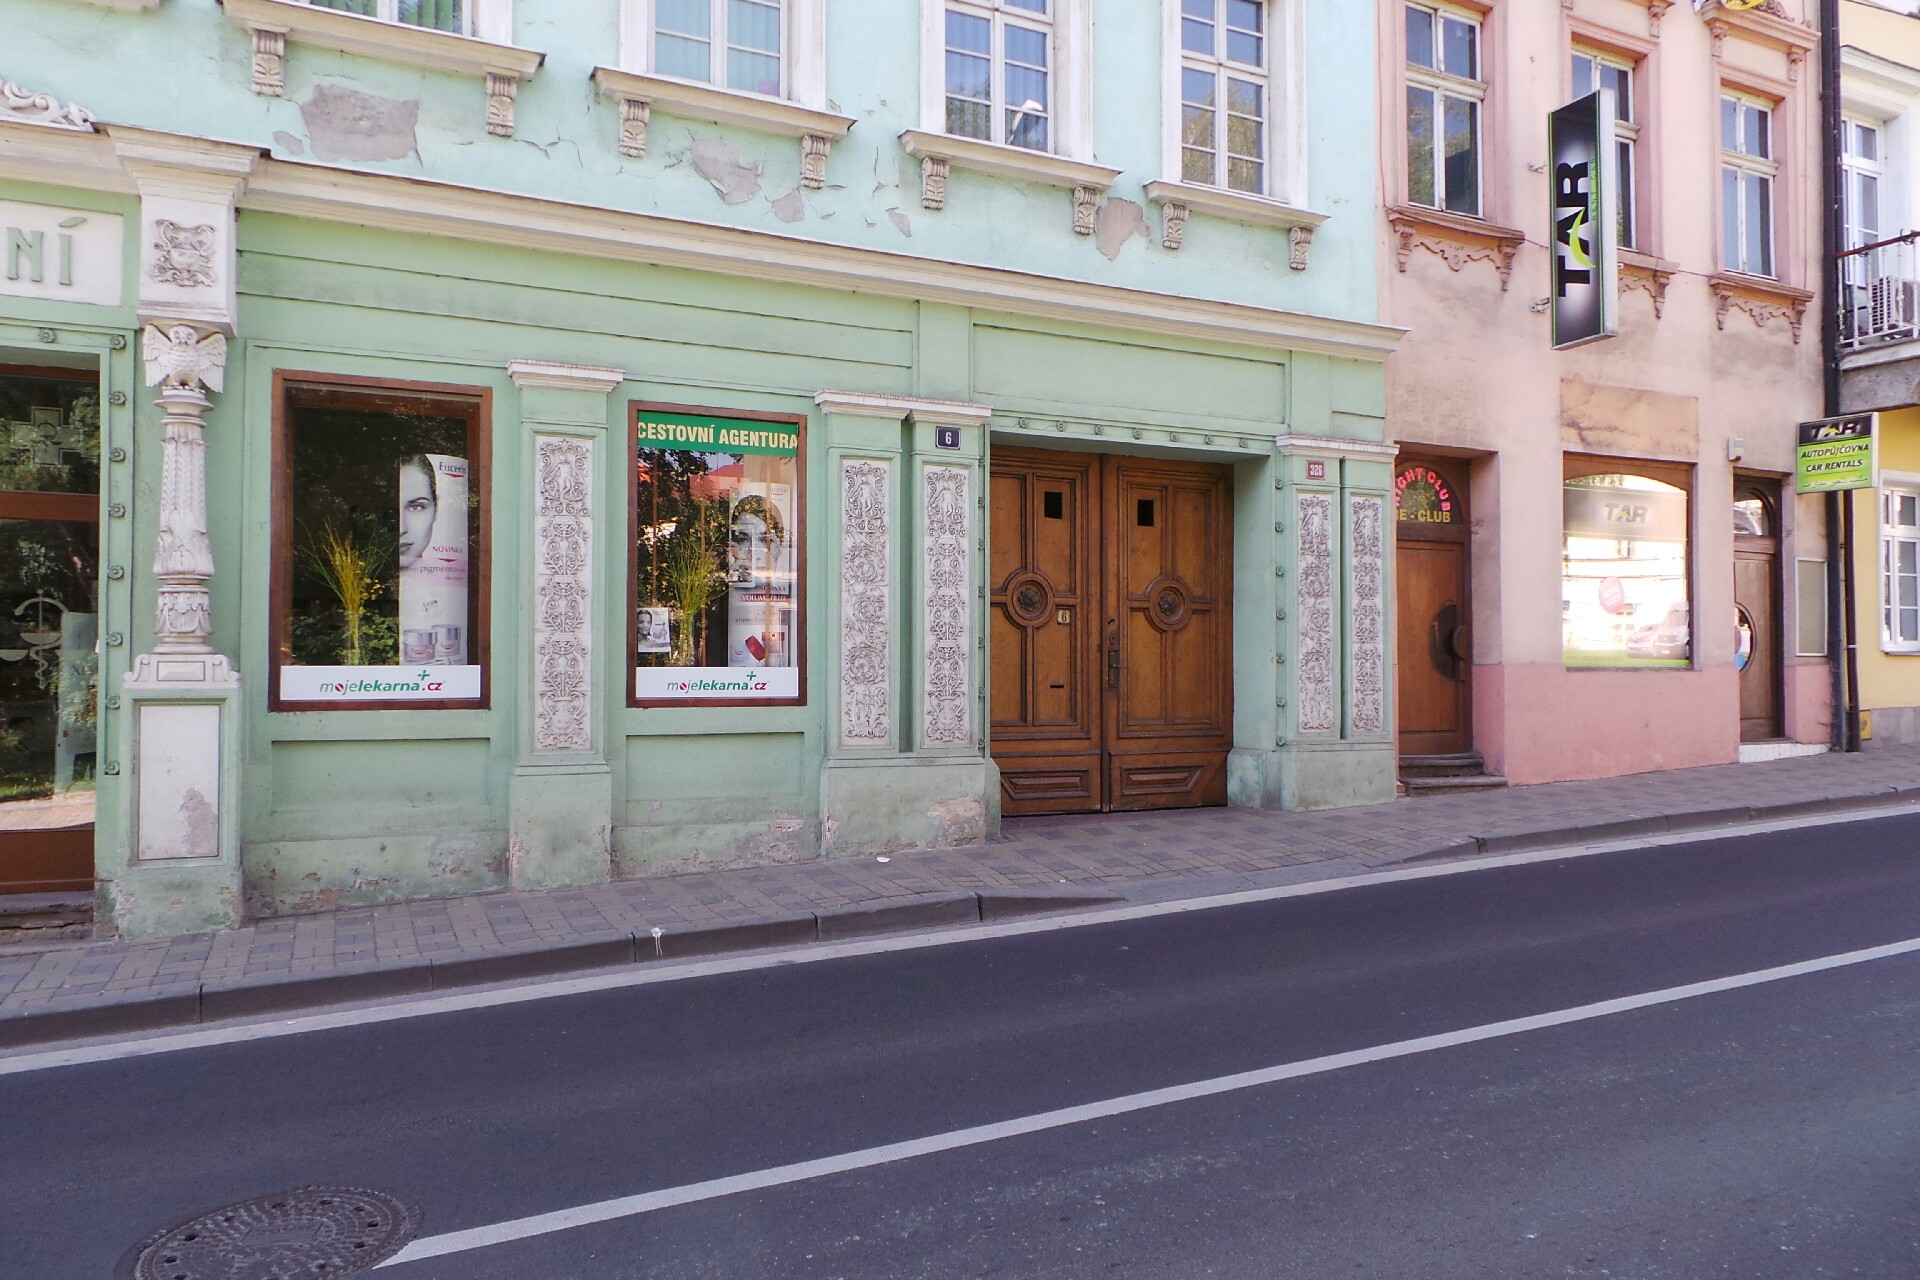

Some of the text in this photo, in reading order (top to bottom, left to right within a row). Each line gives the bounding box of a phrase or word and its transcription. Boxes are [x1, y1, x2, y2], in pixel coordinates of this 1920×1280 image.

[1556, 160, 1591, 297] TAR
[7, 216, 87, 287] NÍ
[638, 421, 798, 449] CESTOVNÍ AGENTURA
[1811, 421, 1859, 438] TAR
[945, 431, 952, 445] 6
[1801, 444, 1869, 458] AUTOPŮJČOVNA
[1310, 464, 1323, 476] 326
[1806, 459, 1863, 472] CAR RENTALS
[1417, 509, 1451, 523] CLUB
[1604, 502, 1649, 523] TAR
[1061, 611, 1067, 623] 6
